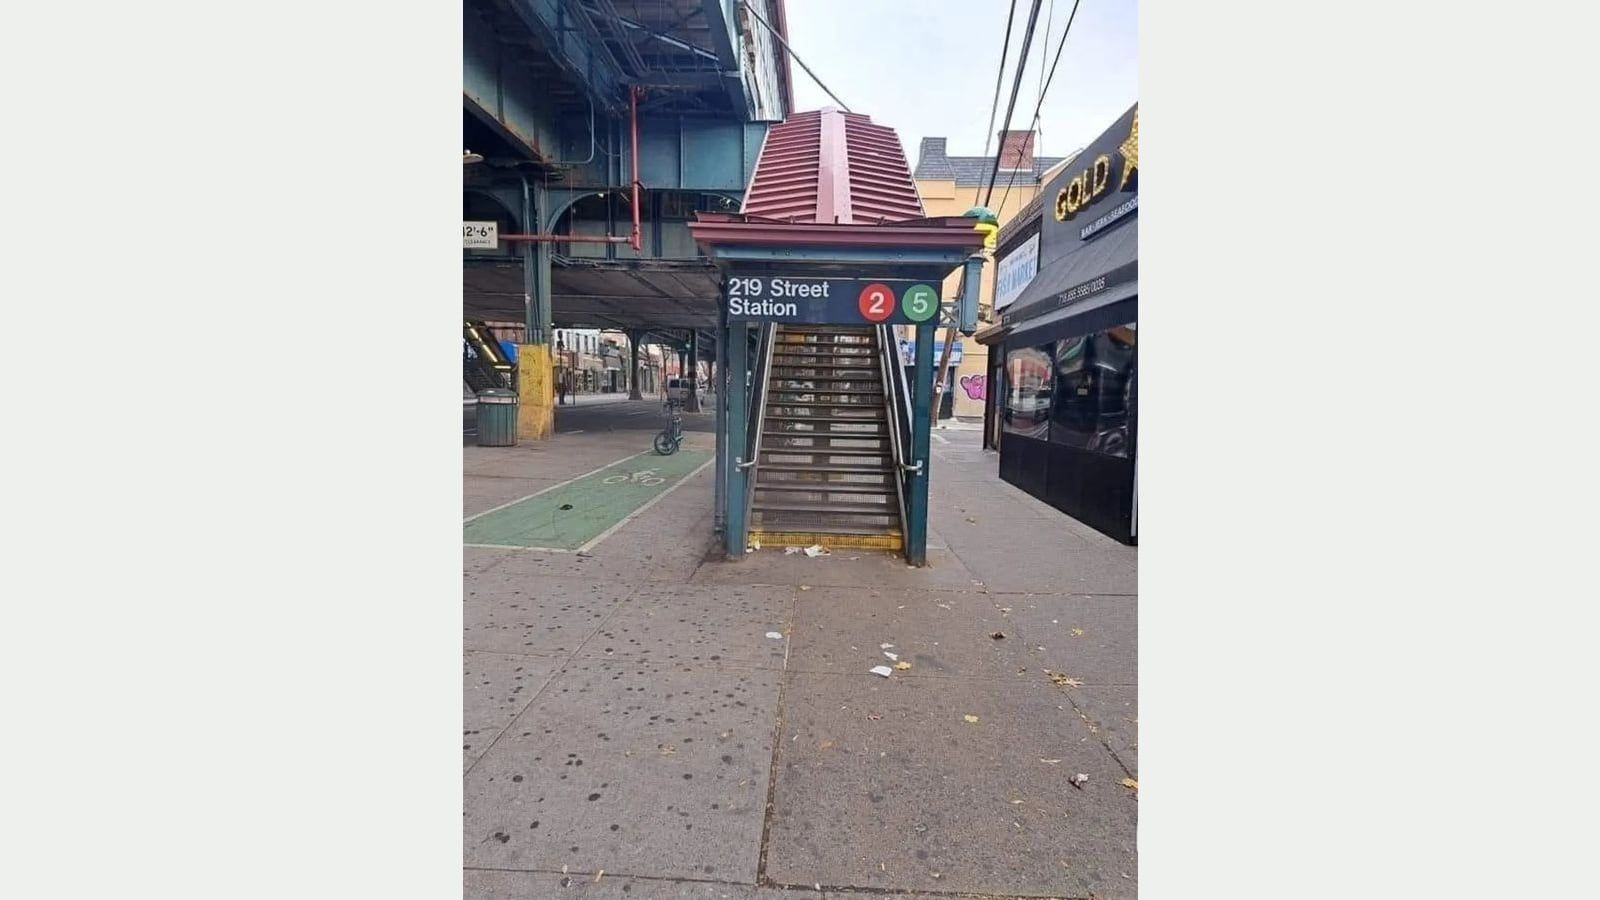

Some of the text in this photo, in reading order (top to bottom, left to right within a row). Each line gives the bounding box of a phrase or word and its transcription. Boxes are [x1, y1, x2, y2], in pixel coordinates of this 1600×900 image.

[1055, 154, 1109, 222] GOLD
[729, 278, 829, 297] 219 Street
[729, 297, 797, 316] Station
[869, 292, 928, 314] 2 5
